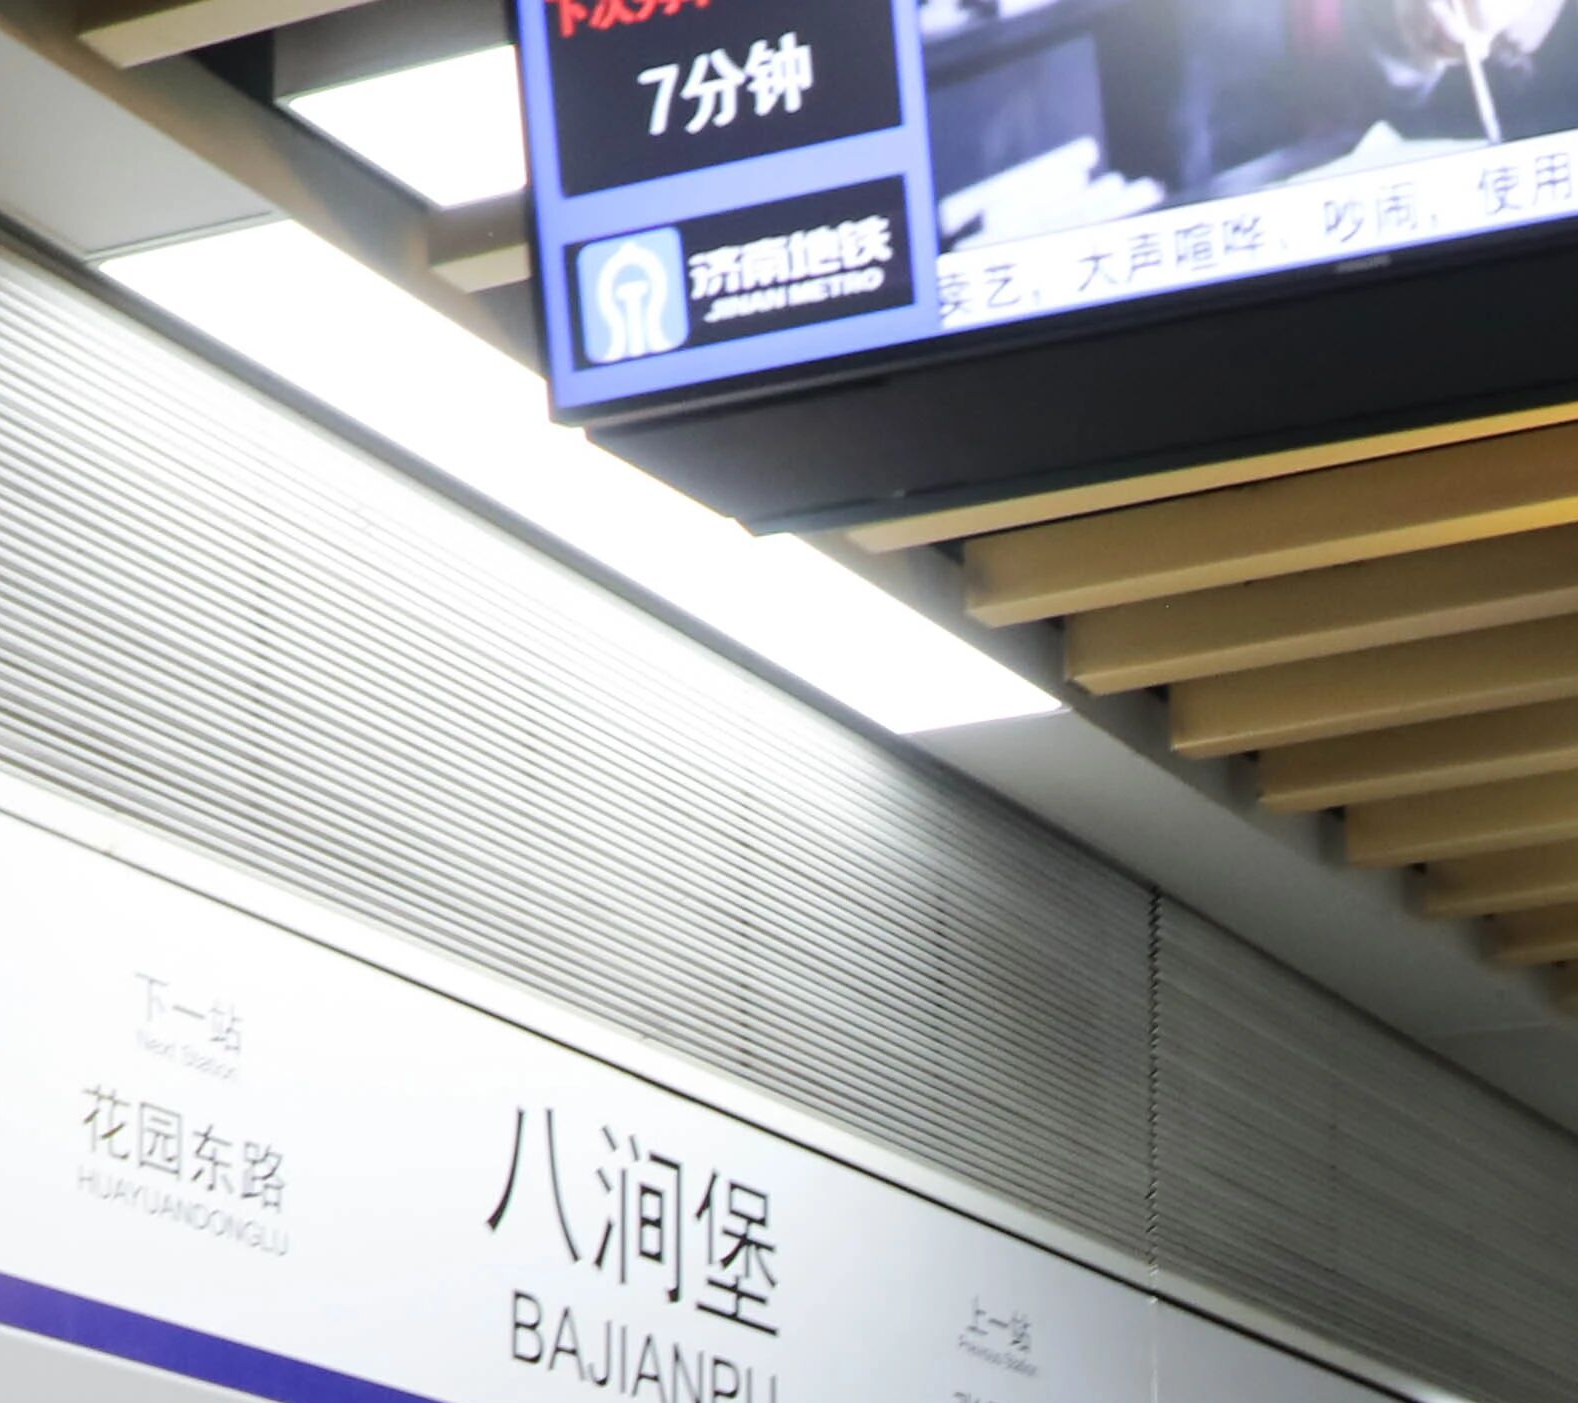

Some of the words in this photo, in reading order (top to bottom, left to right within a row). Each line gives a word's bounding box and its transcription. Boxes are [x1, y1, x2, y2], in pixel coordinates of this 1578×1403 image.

[637, 31, 815, 136] 7分钟
[688, 215, 893, 301] 济南地铁
[135, 971, 242, 1053] 下一站
[82, 1083, 286, 1213] 花园东路
[77, 1165, 290, 1257] HUAYUANDONGLU
[486, 1105, 783, 1338] 八涧堡
[967, 1293, 1032, 1353] 上一站
